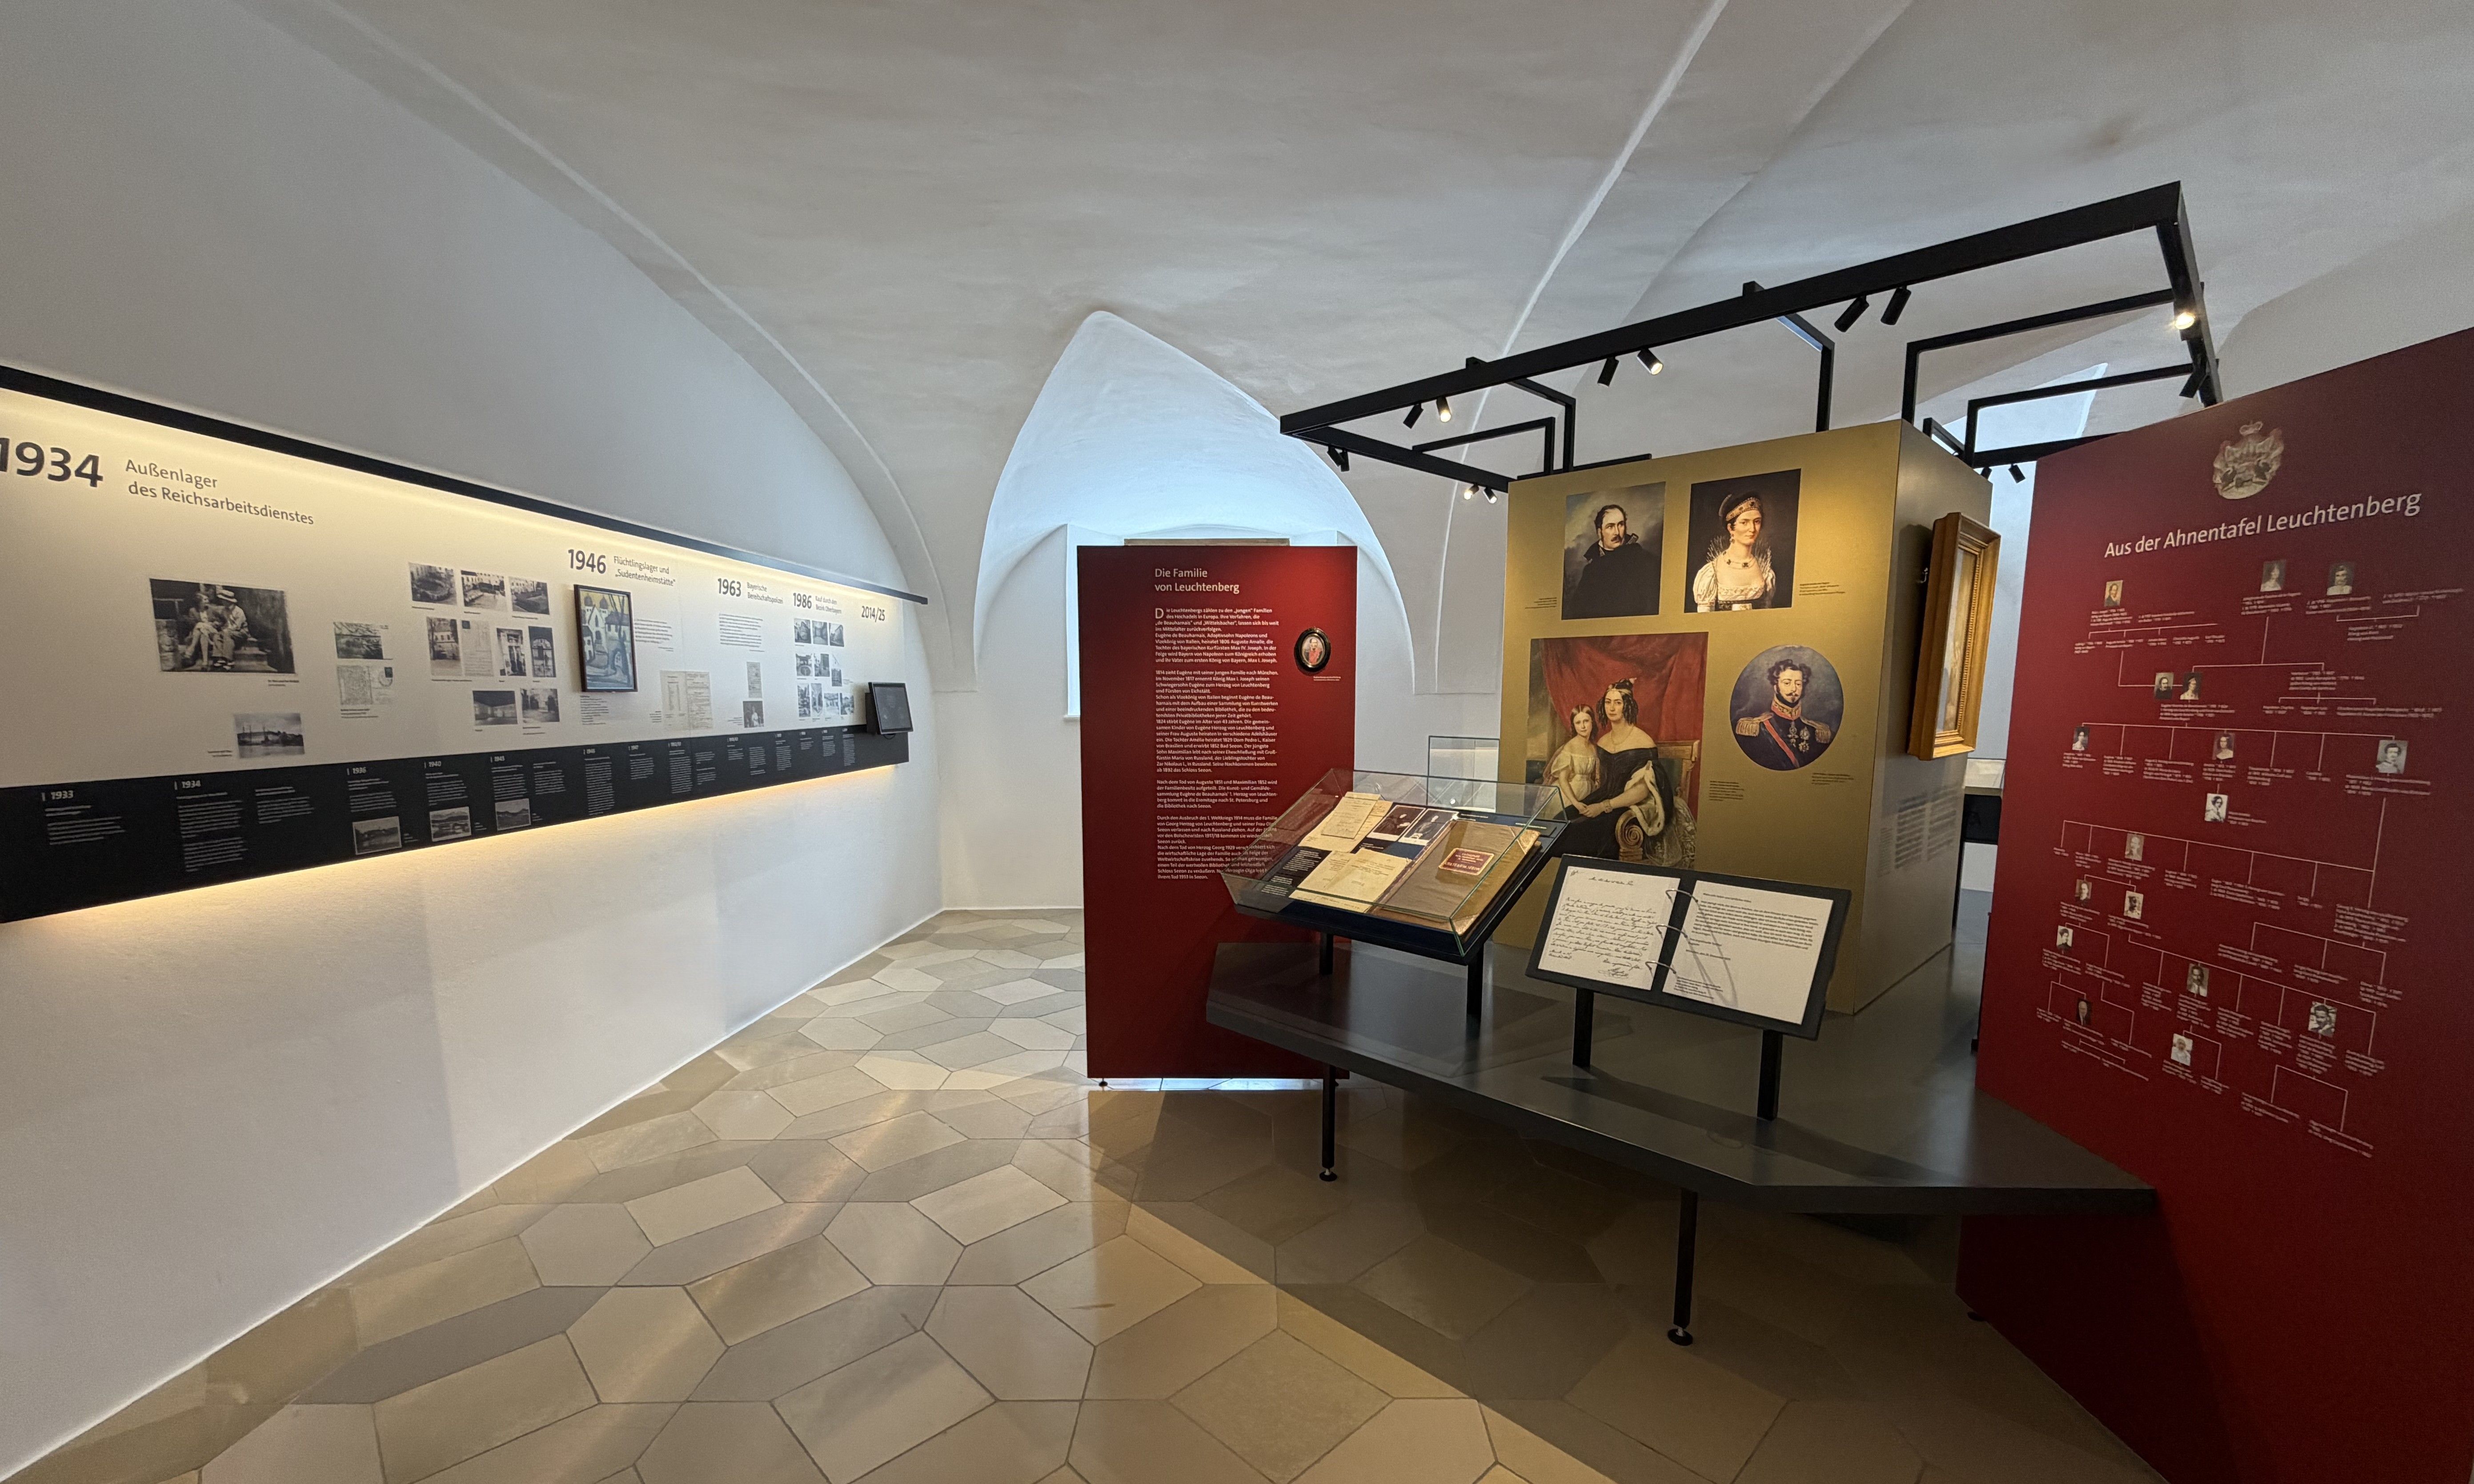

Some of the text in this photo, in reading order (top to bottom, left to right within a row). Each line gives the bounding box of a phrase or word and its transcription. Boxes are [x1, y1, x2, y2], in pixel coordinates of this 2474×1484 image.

[0, 437, 103, 488] 1934
[125, 459, 217, 489] Außenlager
[128, 481, 314, 525] des Reichsarbeitsdienstes
[2104, 493, 2422, 558] Aus der Ahnentafel Leuchtenberg
[568, 549, 606, 574] 1946
[613, 555, 658, 573] Flüchtlingslager
[1155, 568, 1208, 578] Die Familie
[718, 578, 742, 597] 1963
[747, 582, 767, 592] Bayerische
[1175, 582, 1240, 594] Leuchtenberg
[793, 593, 812, 609] 1986
[861, 606, 886, 623] 2014/25
[181, 780, 201, 788] 1934
[51, 790, 74, 800] 1933
